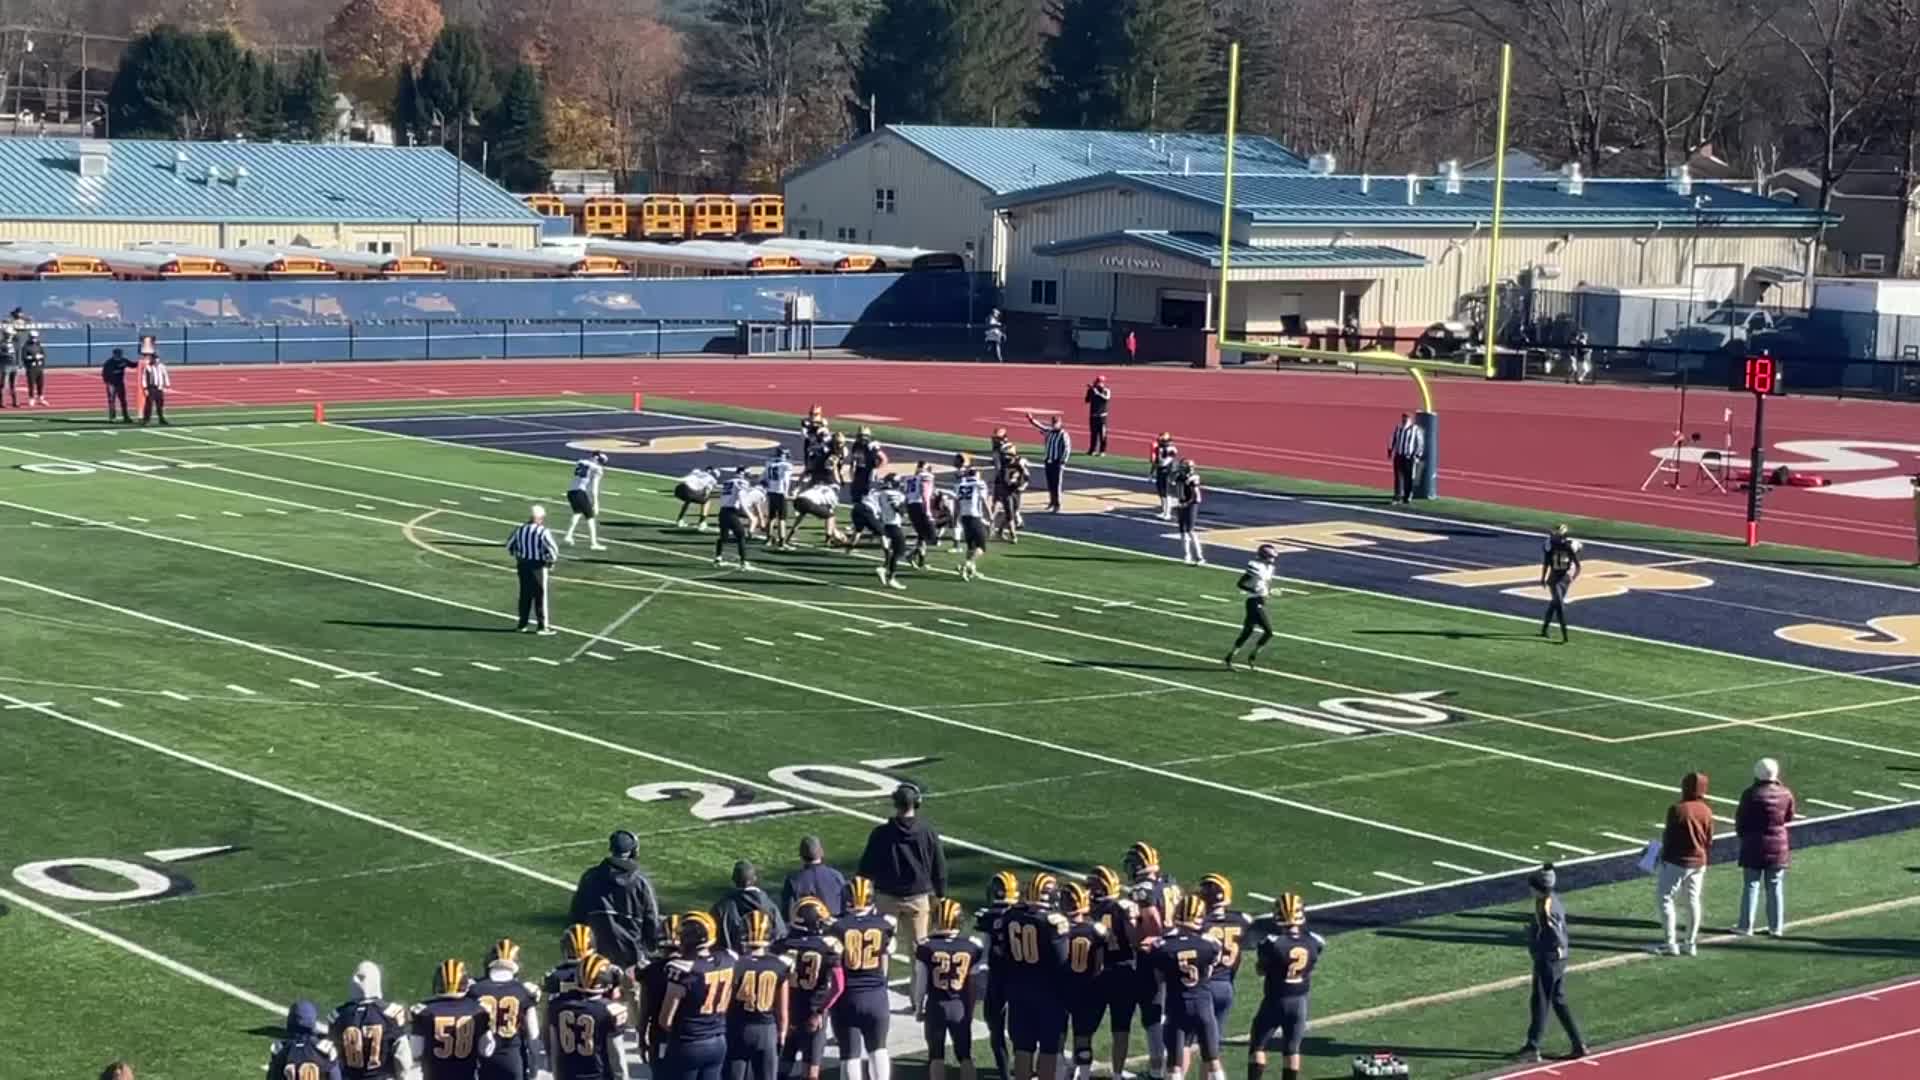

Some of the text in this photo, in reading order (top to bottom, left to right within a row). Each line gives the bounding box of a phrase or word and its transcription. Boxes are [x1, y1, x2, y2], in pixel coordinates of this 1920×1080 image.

[1745, 359, 1771, 392] 18
[1238, 697, 1448, 735] 10
[625, 764, 899, 821] 20
[844, 929, 882, 971] 82
[1008, 920, 1039, 964] 60
[931, 950, 971, 991] 23
[1176, 949, 1199, 987] 5
[1286, 946, 1309, 984] 2
[699, 967, 734, 1014] 77
[736, 970, 778, 1012] 40
[342, 1023, 384, 1071] 87
[432, 1014, 475, 1060] 58
[558, 1010, 595, 1057] 63
